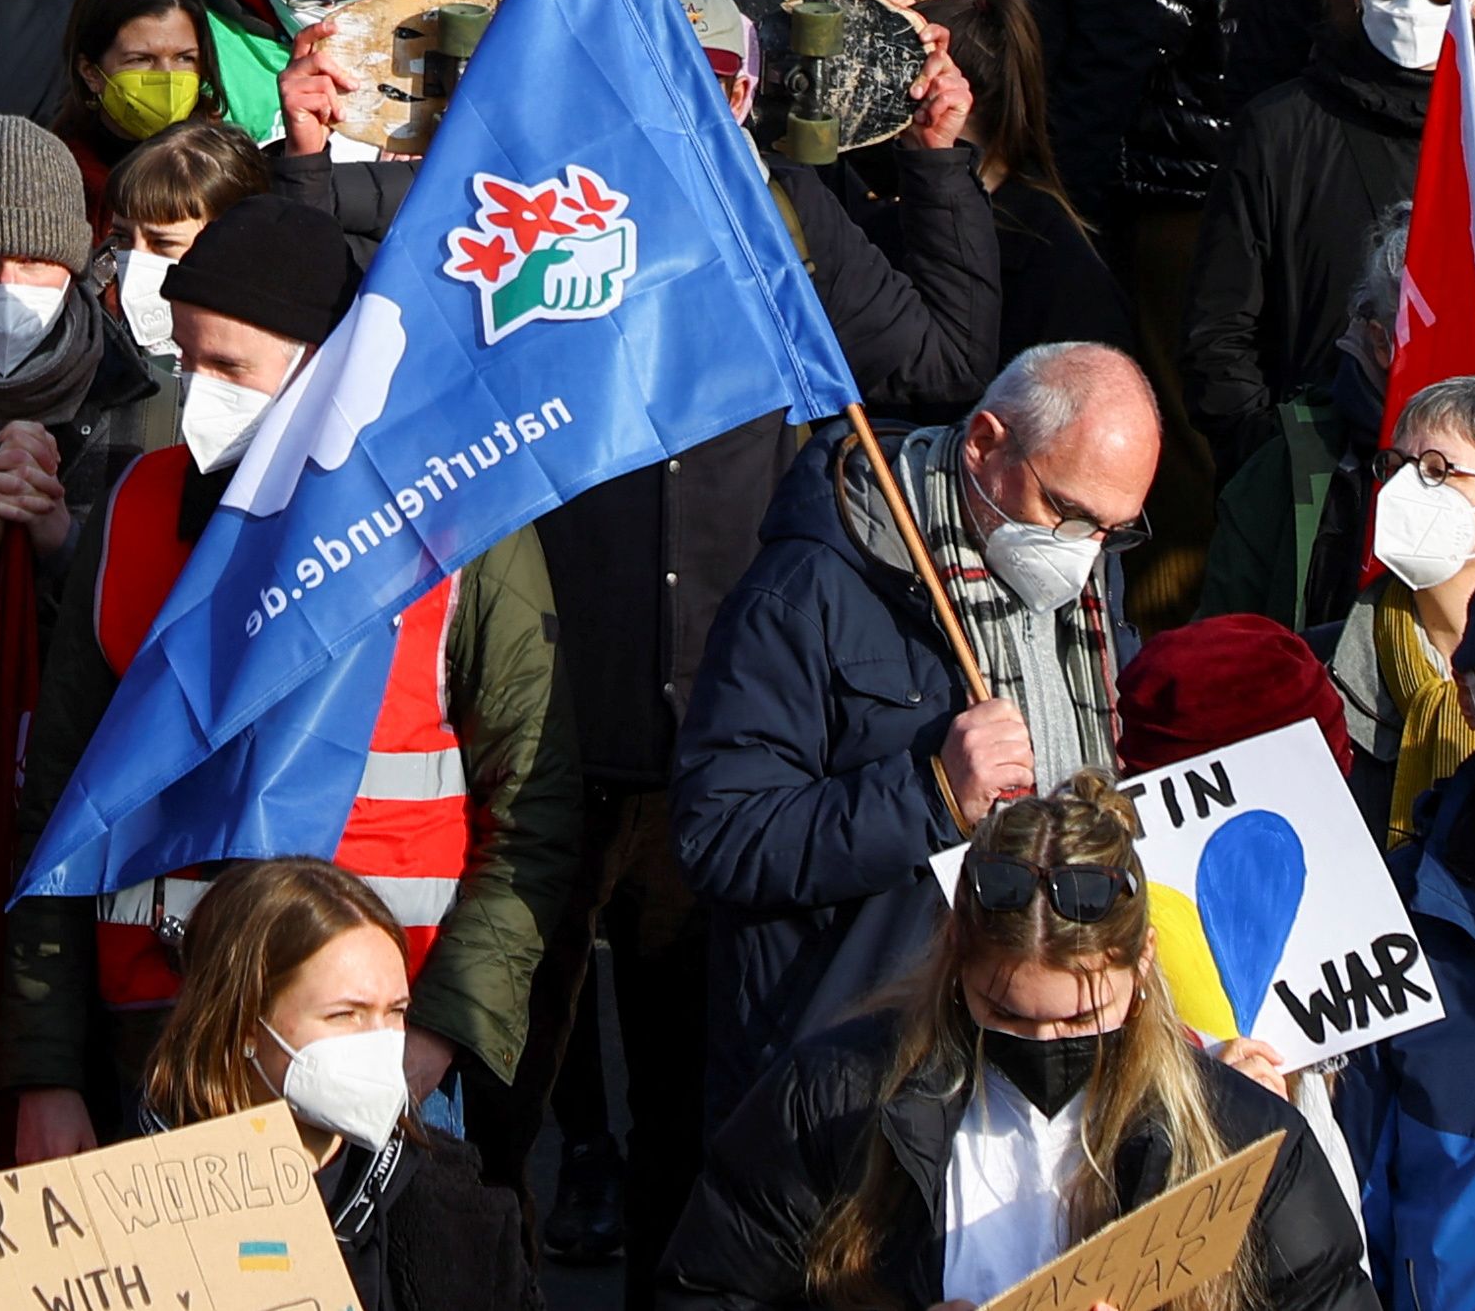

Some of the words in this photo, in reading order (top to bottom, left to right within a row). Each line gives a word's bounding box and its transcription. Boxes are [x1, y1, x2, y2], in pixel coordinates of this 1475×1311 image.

[1273, 932, 1434, 1045] WAR
[42, 1186, 85, 1248] A
[93, 1144, 313, 1235] WORLD
[1140, 1151, 1268, 1259] LOVE
[32, 1264, 155, 1311] WITH
